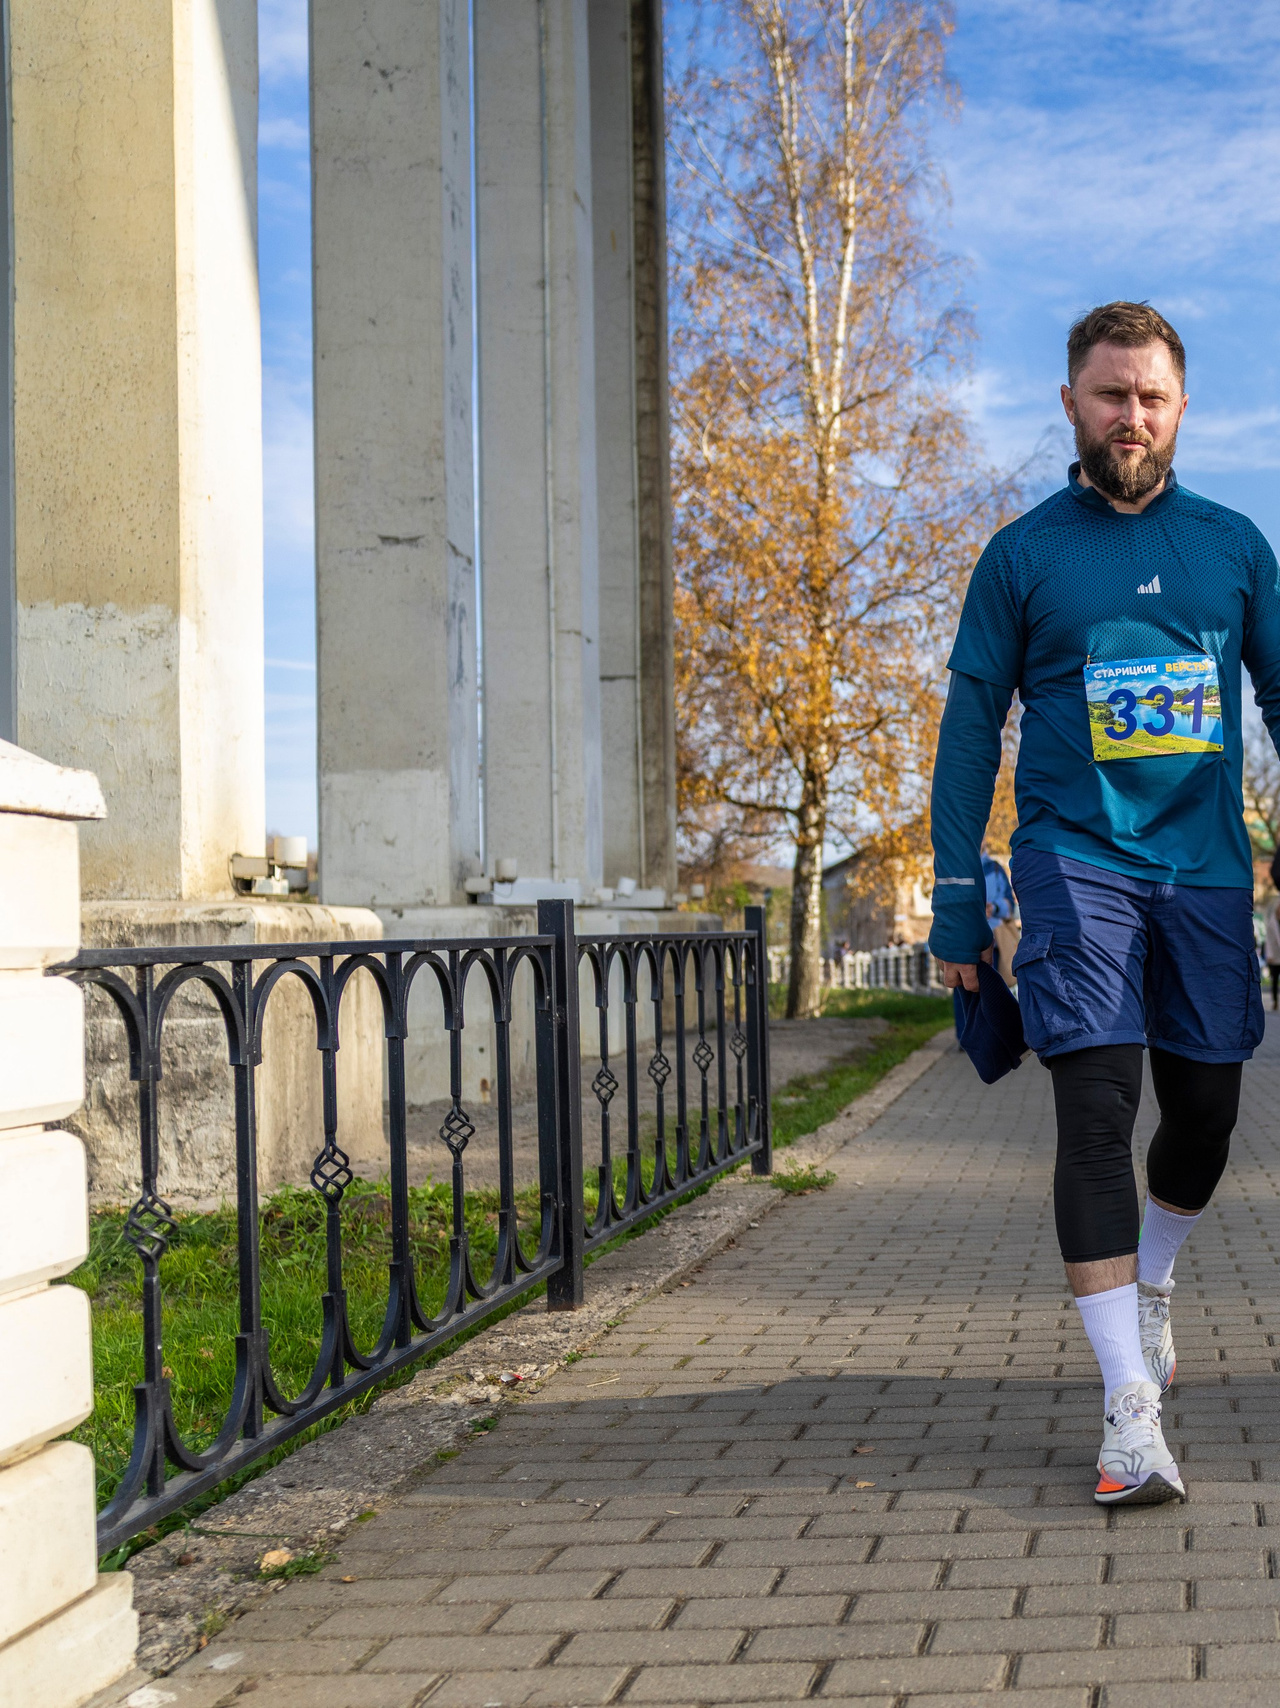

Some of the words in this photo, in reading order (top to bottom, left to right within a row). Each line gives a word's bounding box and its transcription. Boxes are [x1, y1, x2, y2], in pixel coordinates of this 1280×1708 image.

[1093, 665, 1157, 679] СТАРИЦКИЕ
[1165, 662, 1208, 672] ВЕРСТЫ
[1104, 683, 1204, 740] 331
